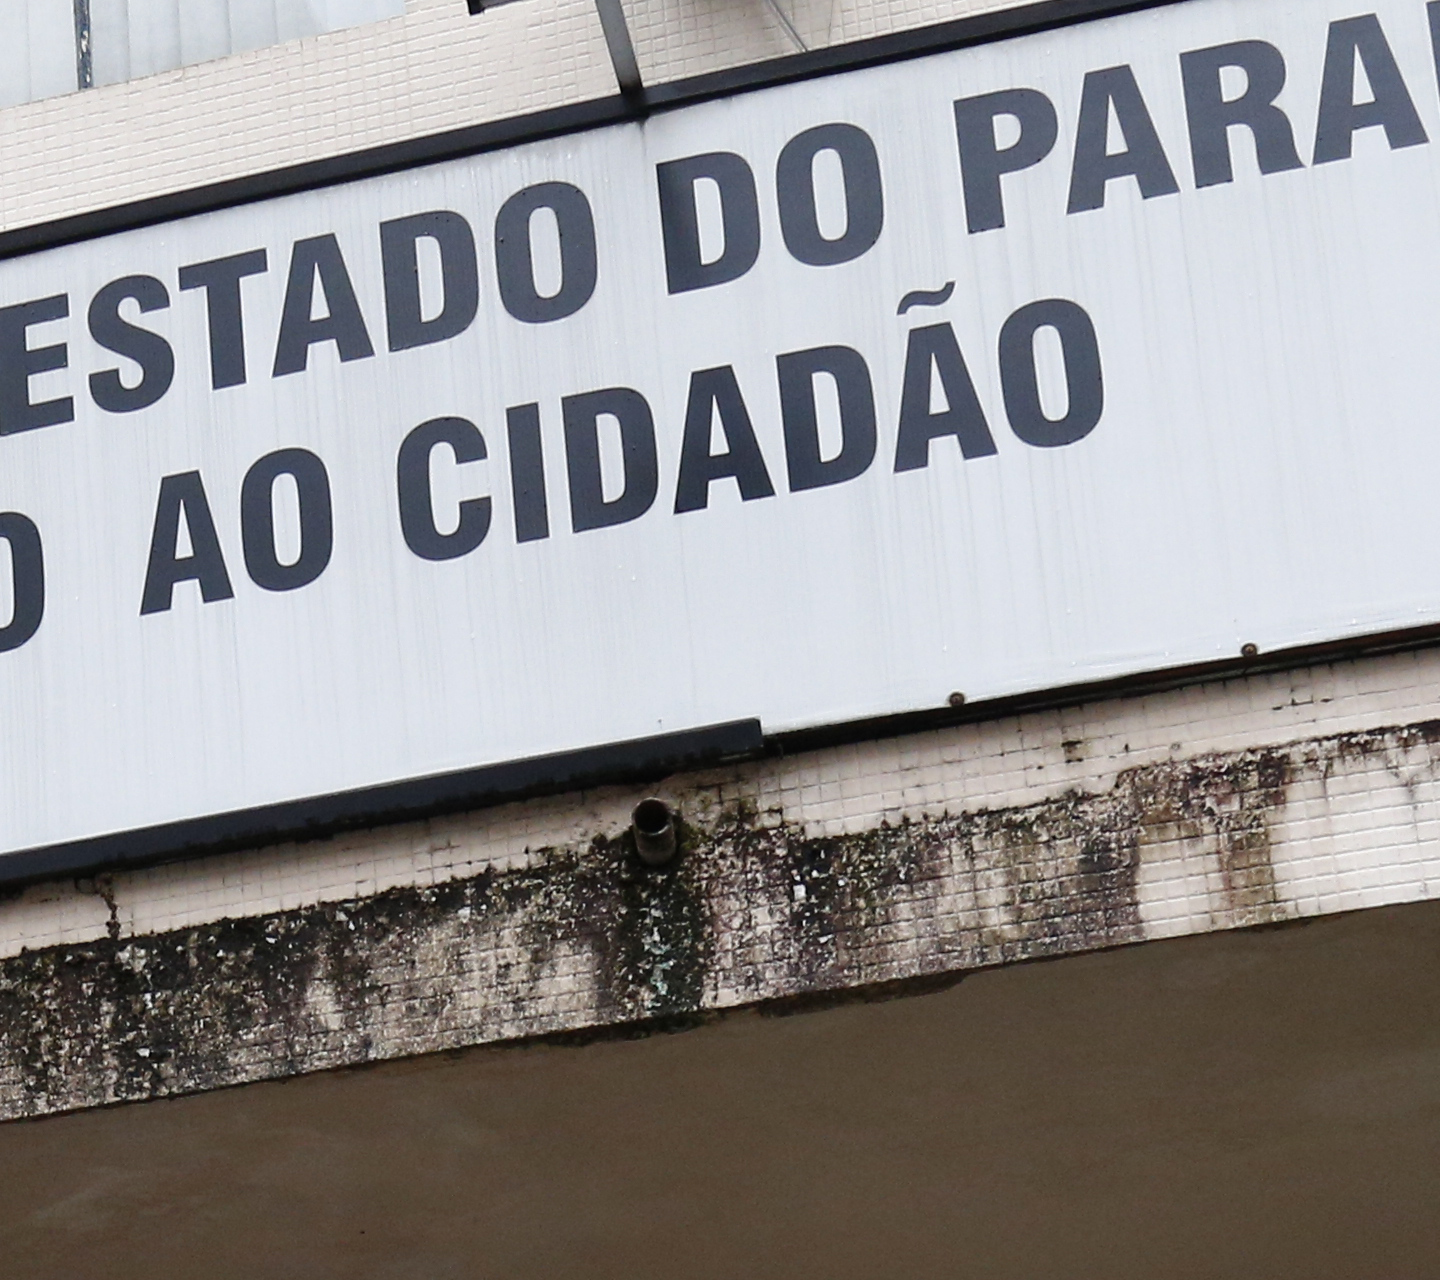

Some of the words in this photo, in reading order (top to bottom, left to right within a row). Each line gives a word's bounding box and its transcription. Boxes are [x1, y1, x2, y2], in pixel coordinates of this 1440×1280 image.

[656, 124, 883, 294] DO
[140, 448, 332, 615] AO
[398, 282, 1103, 560] CIDADÃO
